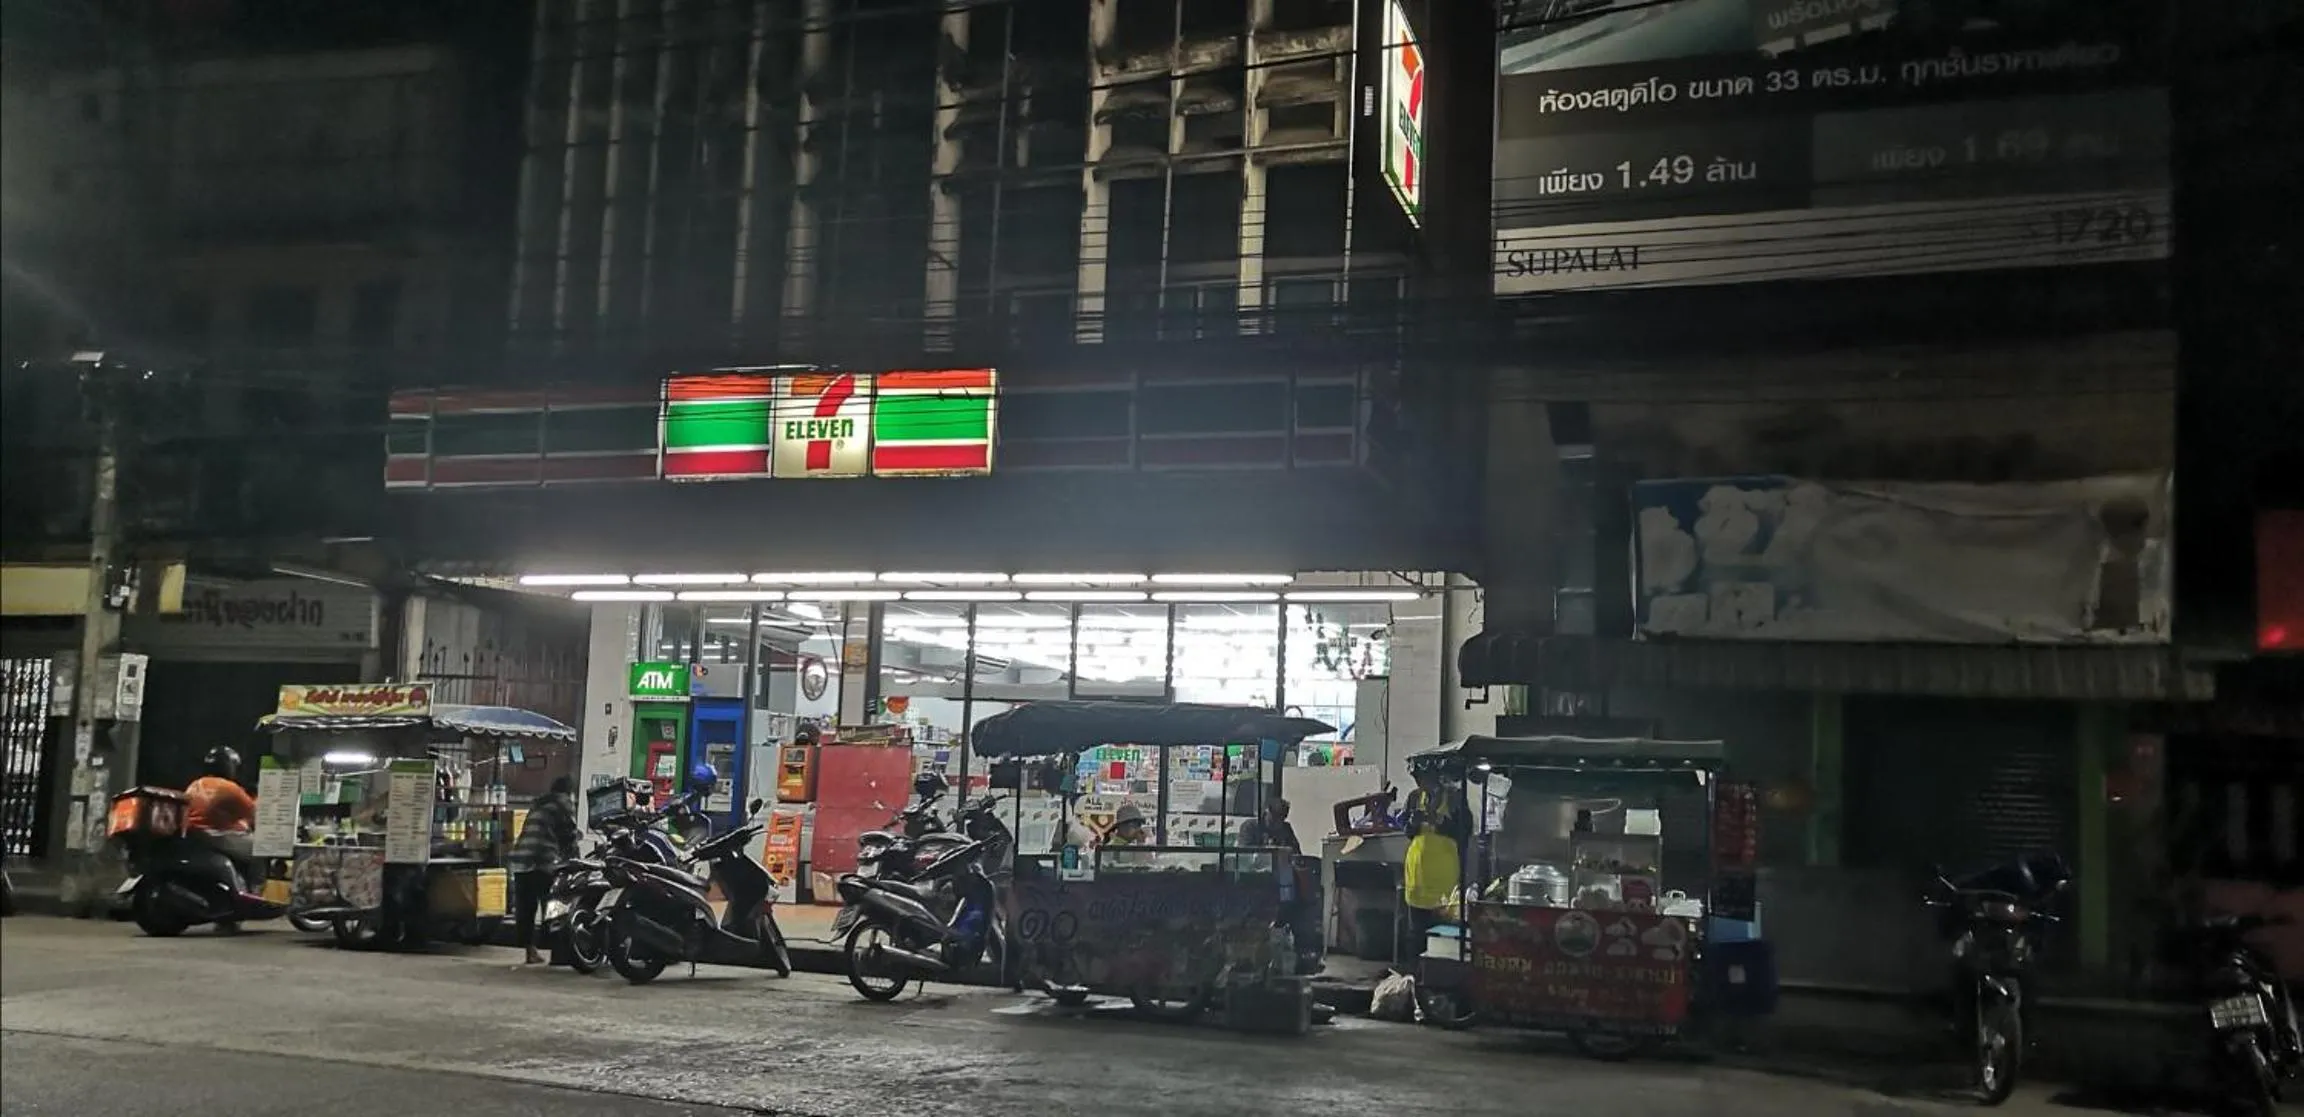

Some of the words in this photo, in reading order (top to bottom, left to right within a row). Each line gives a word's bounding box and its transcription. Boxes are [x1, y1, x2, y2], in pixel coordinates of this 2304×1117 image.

[1539, 76, 1677, 113] ห้องสตูดิโอ
[1688, 75, 1754, 99] ขนาด
[1765, 69, 1800, 93] 33
[1811, 64, 1887, 89] ตร.ม.
[1539, 167, 1604, 195] เพียง
[1616, 155, 1695, 189] 1.49
[1705, 155, 1757, 183] ล้าน
[637, 670, 674, 689] ATM
